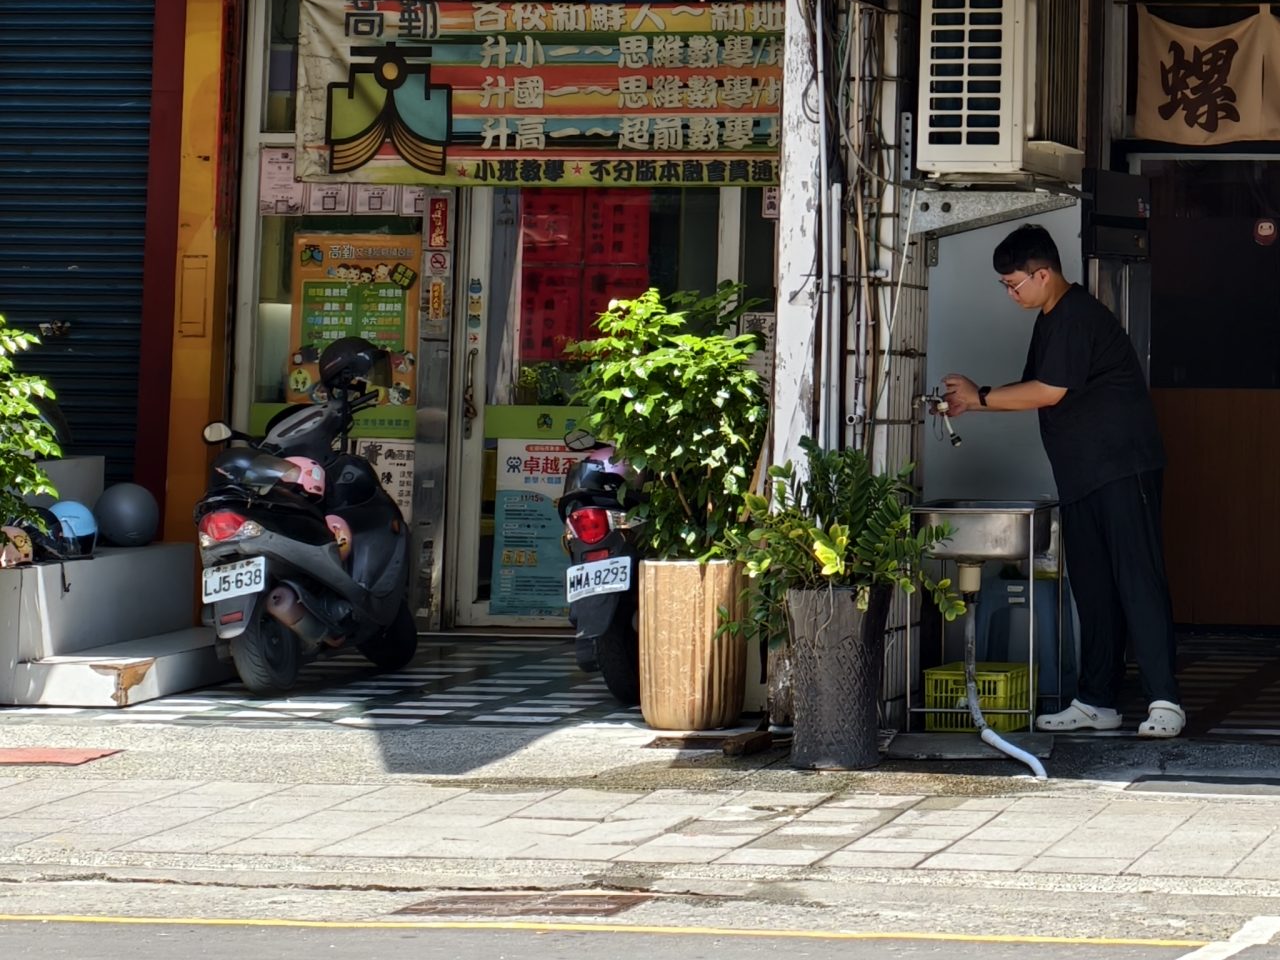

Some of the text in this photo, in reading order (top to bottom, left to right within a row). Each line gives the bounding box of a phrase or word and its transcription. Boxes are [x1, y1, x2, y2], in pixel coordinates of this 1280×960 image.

[589, 159, 781, 182] 不分版本融會貫通
